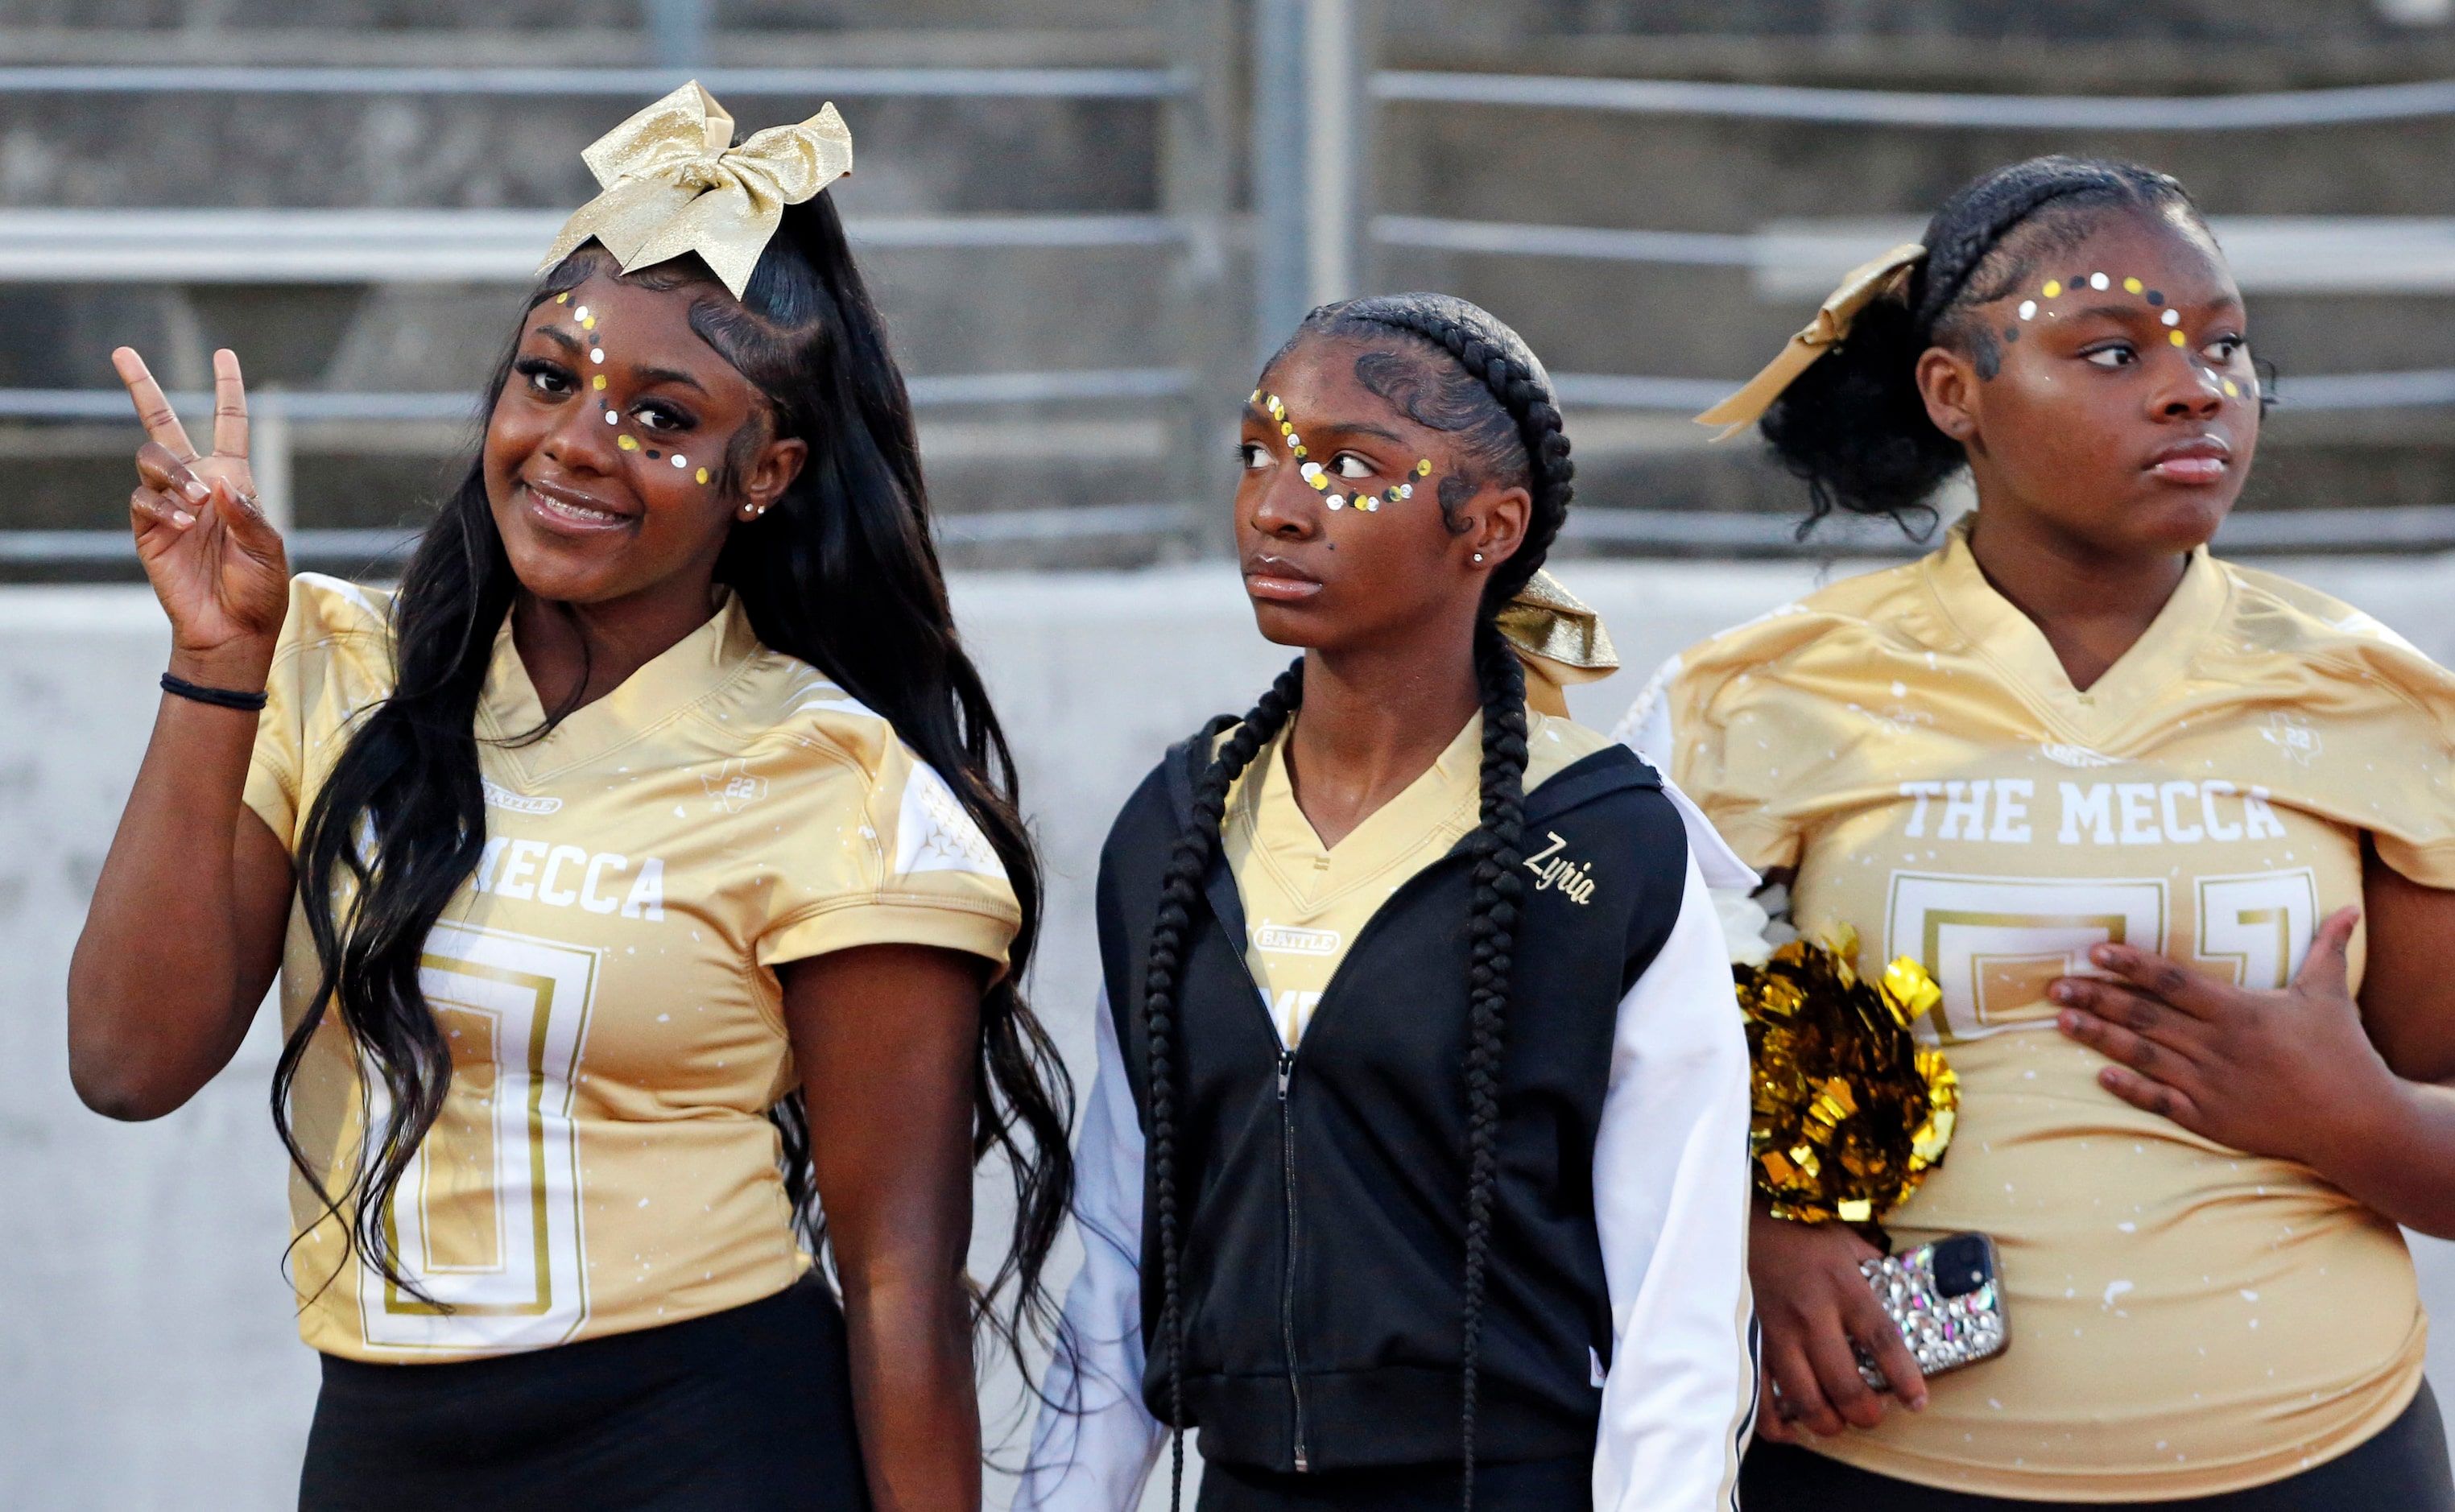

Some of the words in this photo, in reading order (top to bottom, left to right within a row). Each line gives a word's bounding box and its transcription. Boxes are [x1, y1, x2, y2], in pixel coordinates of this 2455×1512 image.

[726, 777, 755, 799] 22
[1899, 779, 2033, 844] THE
[2057, 780, 2286, 845] MECCA
[1523, 831, 1595, 905] Zyria
[1261, 930, 1333, 950] BATTLE
